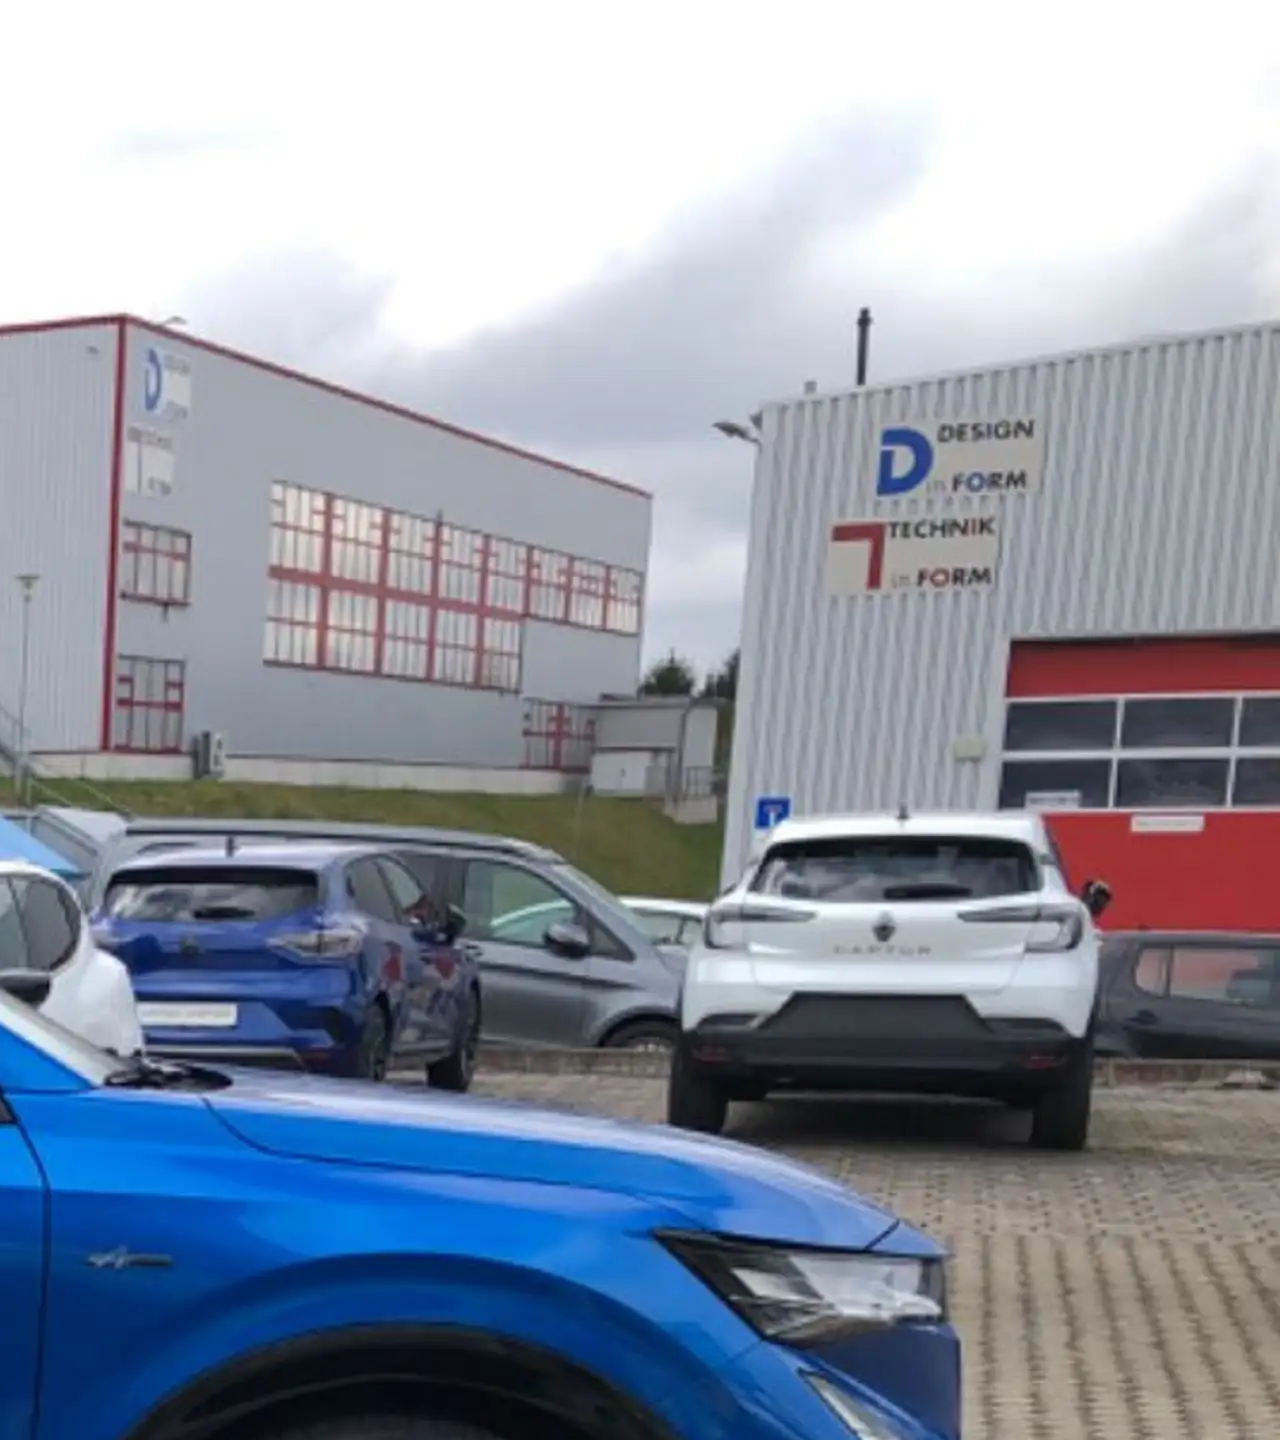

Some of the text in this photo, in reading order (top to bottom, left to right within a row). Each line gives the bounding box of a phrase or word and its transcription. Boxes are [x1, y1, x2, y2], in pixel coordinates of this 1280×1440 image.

[937, 419, 1035, 443] DESIGN
[952, 468, 1027, 493] FORM
[888, 516, 996, 540] TECHNIK
[916, 566, 992, 590] FORM
